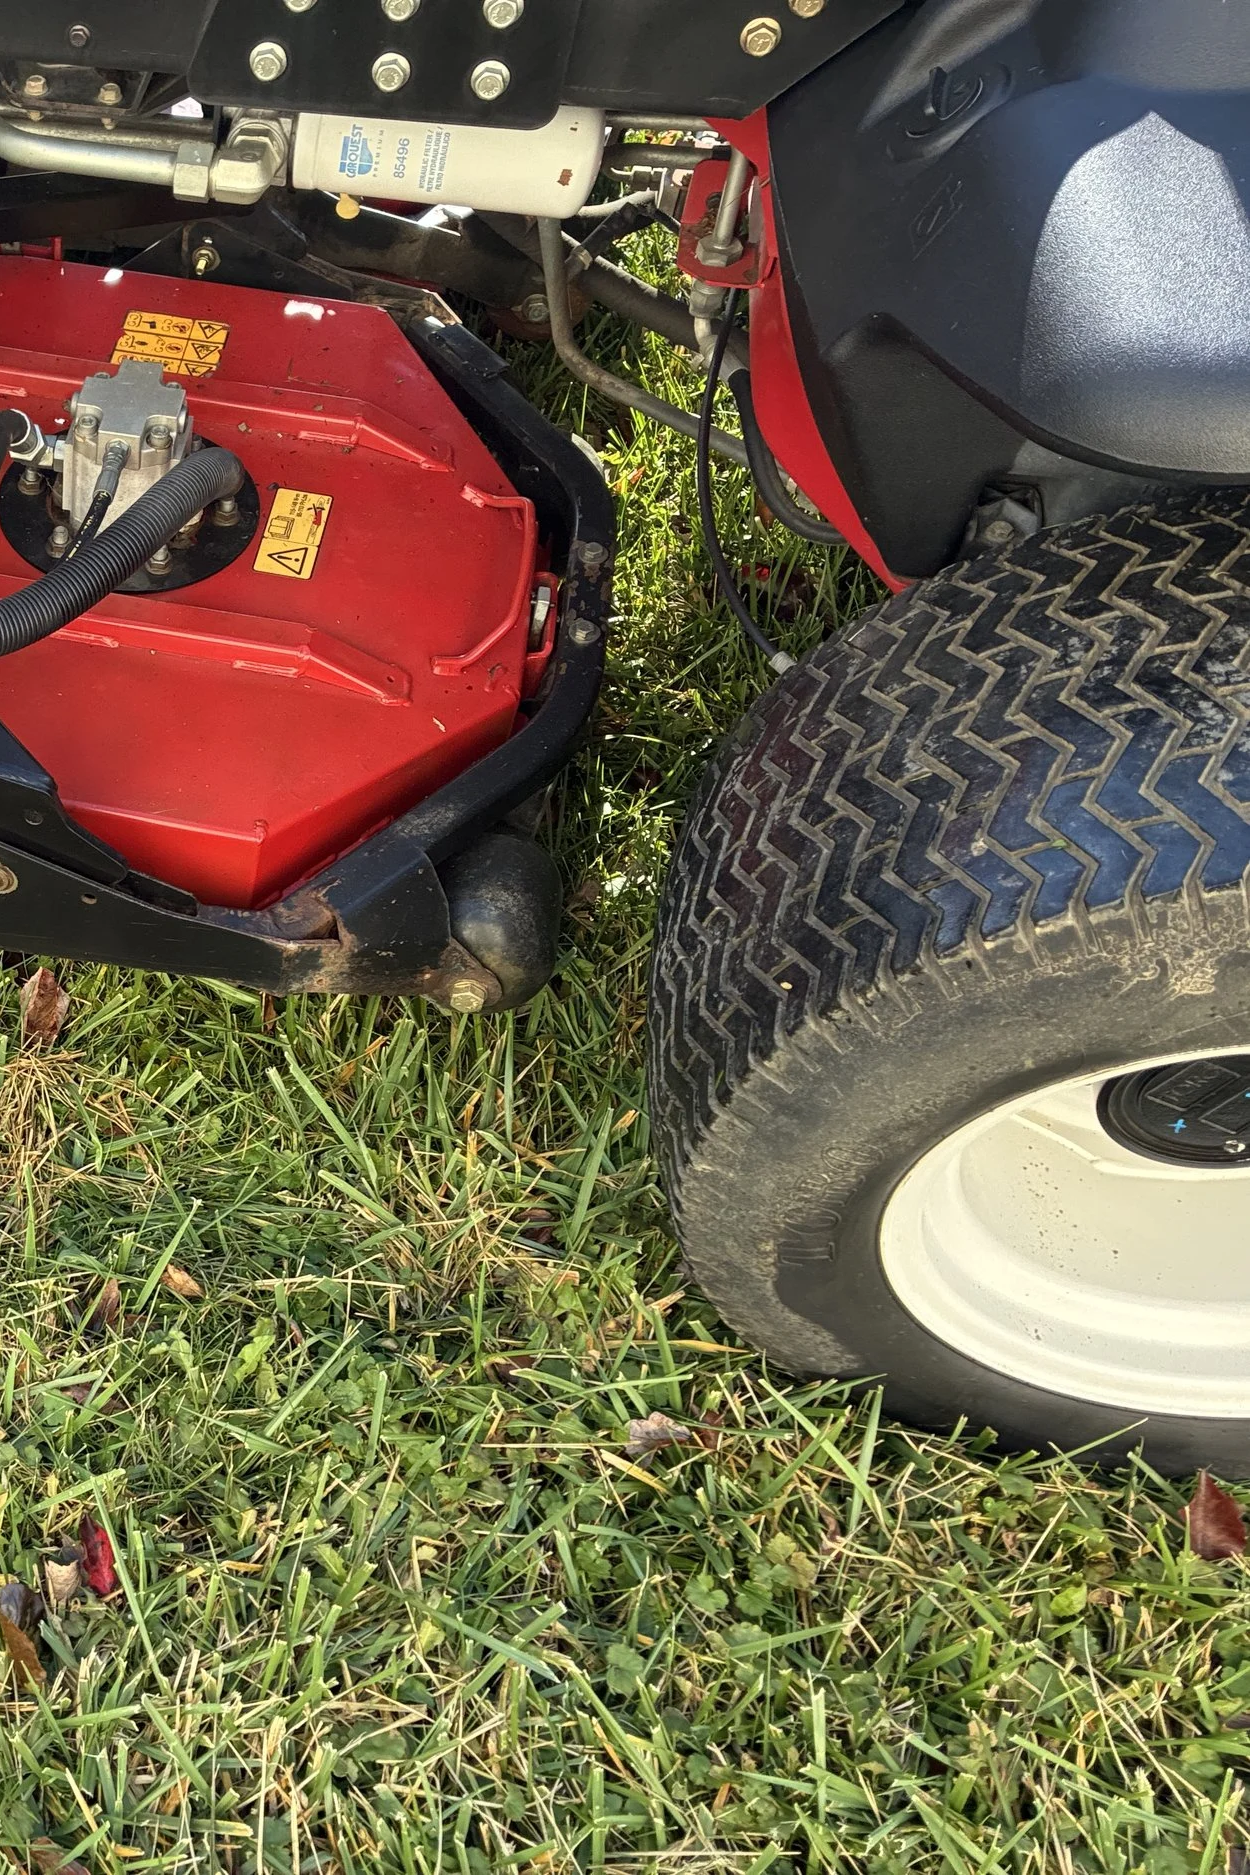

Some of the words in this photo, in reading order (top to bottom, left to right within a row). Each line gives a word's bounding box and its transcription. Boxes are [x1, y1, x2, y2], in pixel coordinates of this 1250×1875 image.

[346, 123, 364, 178] CARQUEST
[372, 129, 385, 178] PREMIUM
[393, 138, 410, 178] 85496
[423, 134, 433, 157] FILTER
[419, 157, 429, 189] HYDRAULIC
[776, 1140, 885, 1267] TORO
